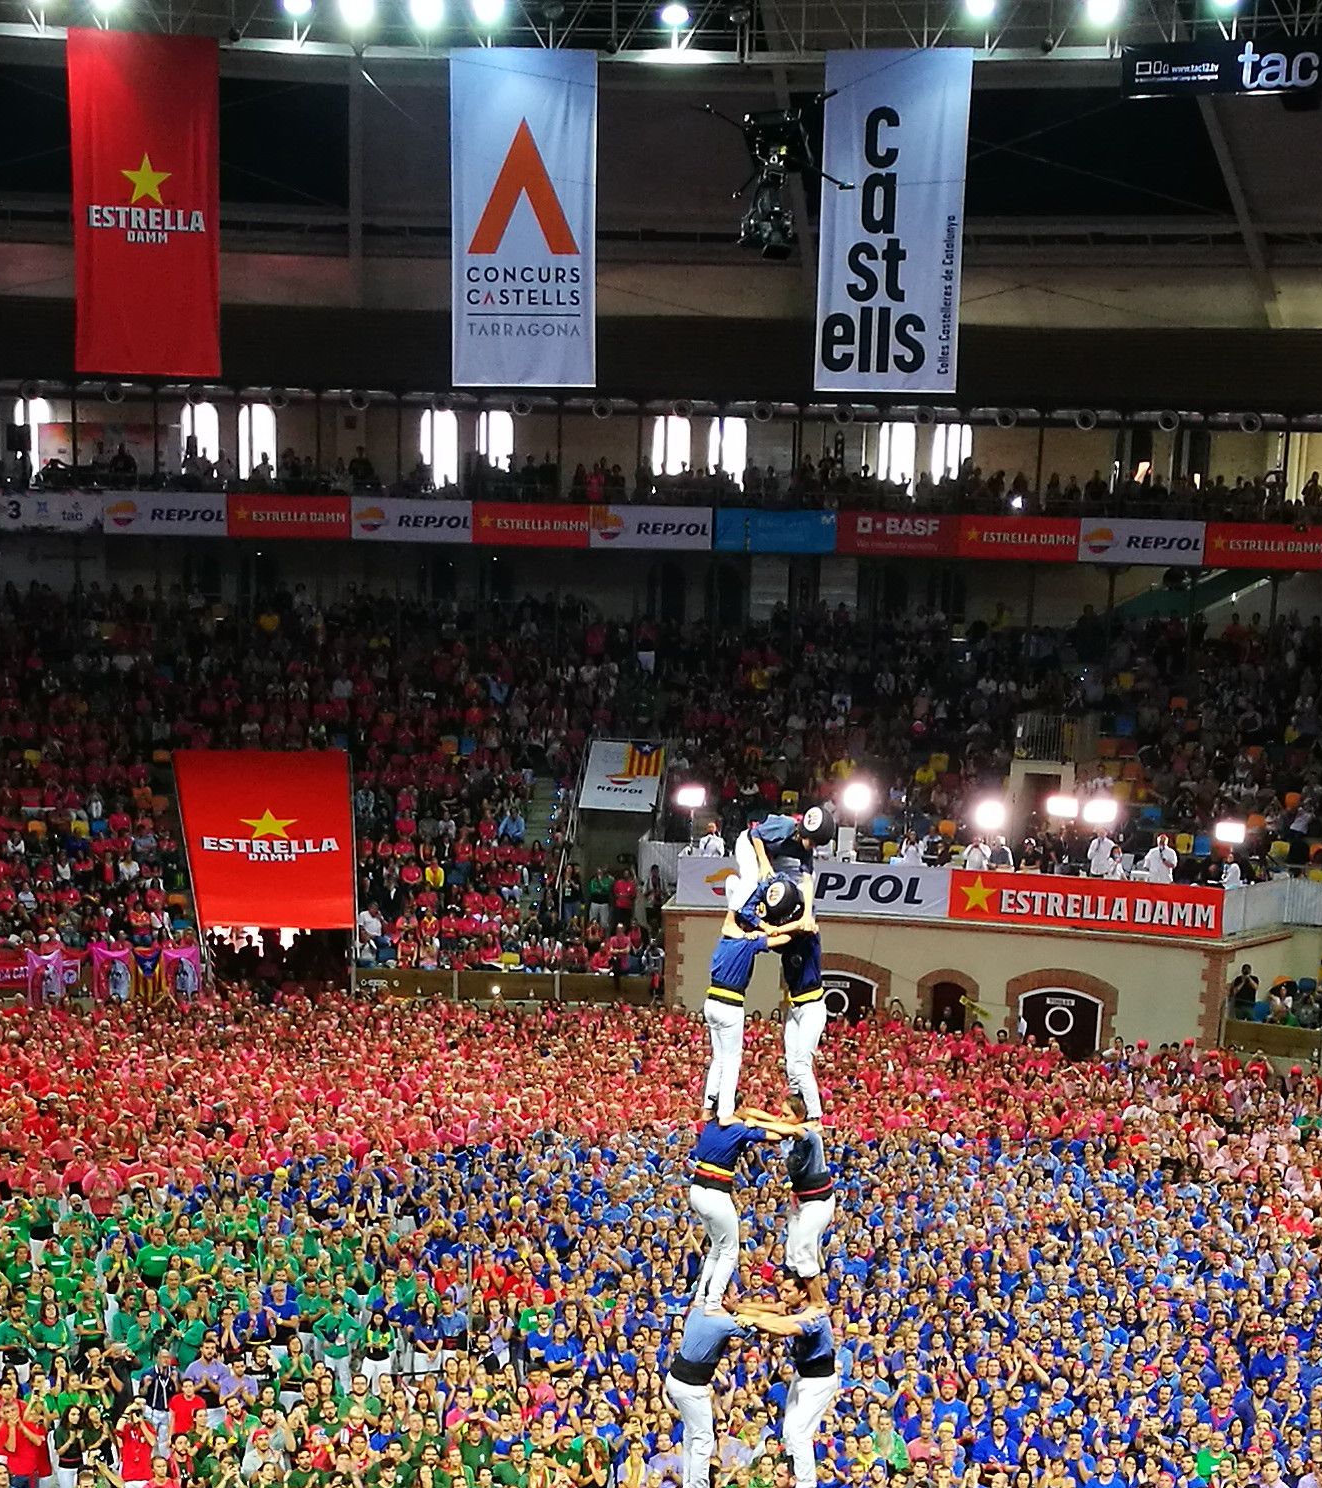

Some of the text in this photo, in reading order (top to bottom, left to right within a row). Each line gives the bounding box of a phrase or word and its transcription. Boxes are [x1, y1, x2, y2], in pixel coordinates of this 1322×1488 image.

[1238, 40, 1319, 89] tac
[87, 204, 205, 233] ESTRELLA
[126, 230, 168, 244] DAMM
[466, 266, 580, 284] CONCURS
[941, 270, 953, 281] de
[466, 289, 580, 306] CASTELLS
[467, 322, 581, 337] TARRAGONA
[937, 345, 950, 375] Colles
[8, 500, 21, 519] 3
[150, 507, 224, 522] REPSOL
[251, 511, 346, 523] ESTRELLA DAMM
[397, 514, 471, 530] REPSOL
[496, 518, 589, 532] ESTRELLA DAMM
[635, 521, 709, 536] REPSOL
[886, 518, 940, 535] BASF
[982, 531, 1038, 544] ESTRELLA
[1126, 535, 1201, 551] REPSOL
[1228, 539, 1286, 552] ESTRELLA
[202, 836, 340, 854] ESTRELLA
[248, 853, 297, 861] DAMM
[816, 873, 923, 905] PSOL
[1001, 888, 1217, 930] ESTRELLA DAMM
